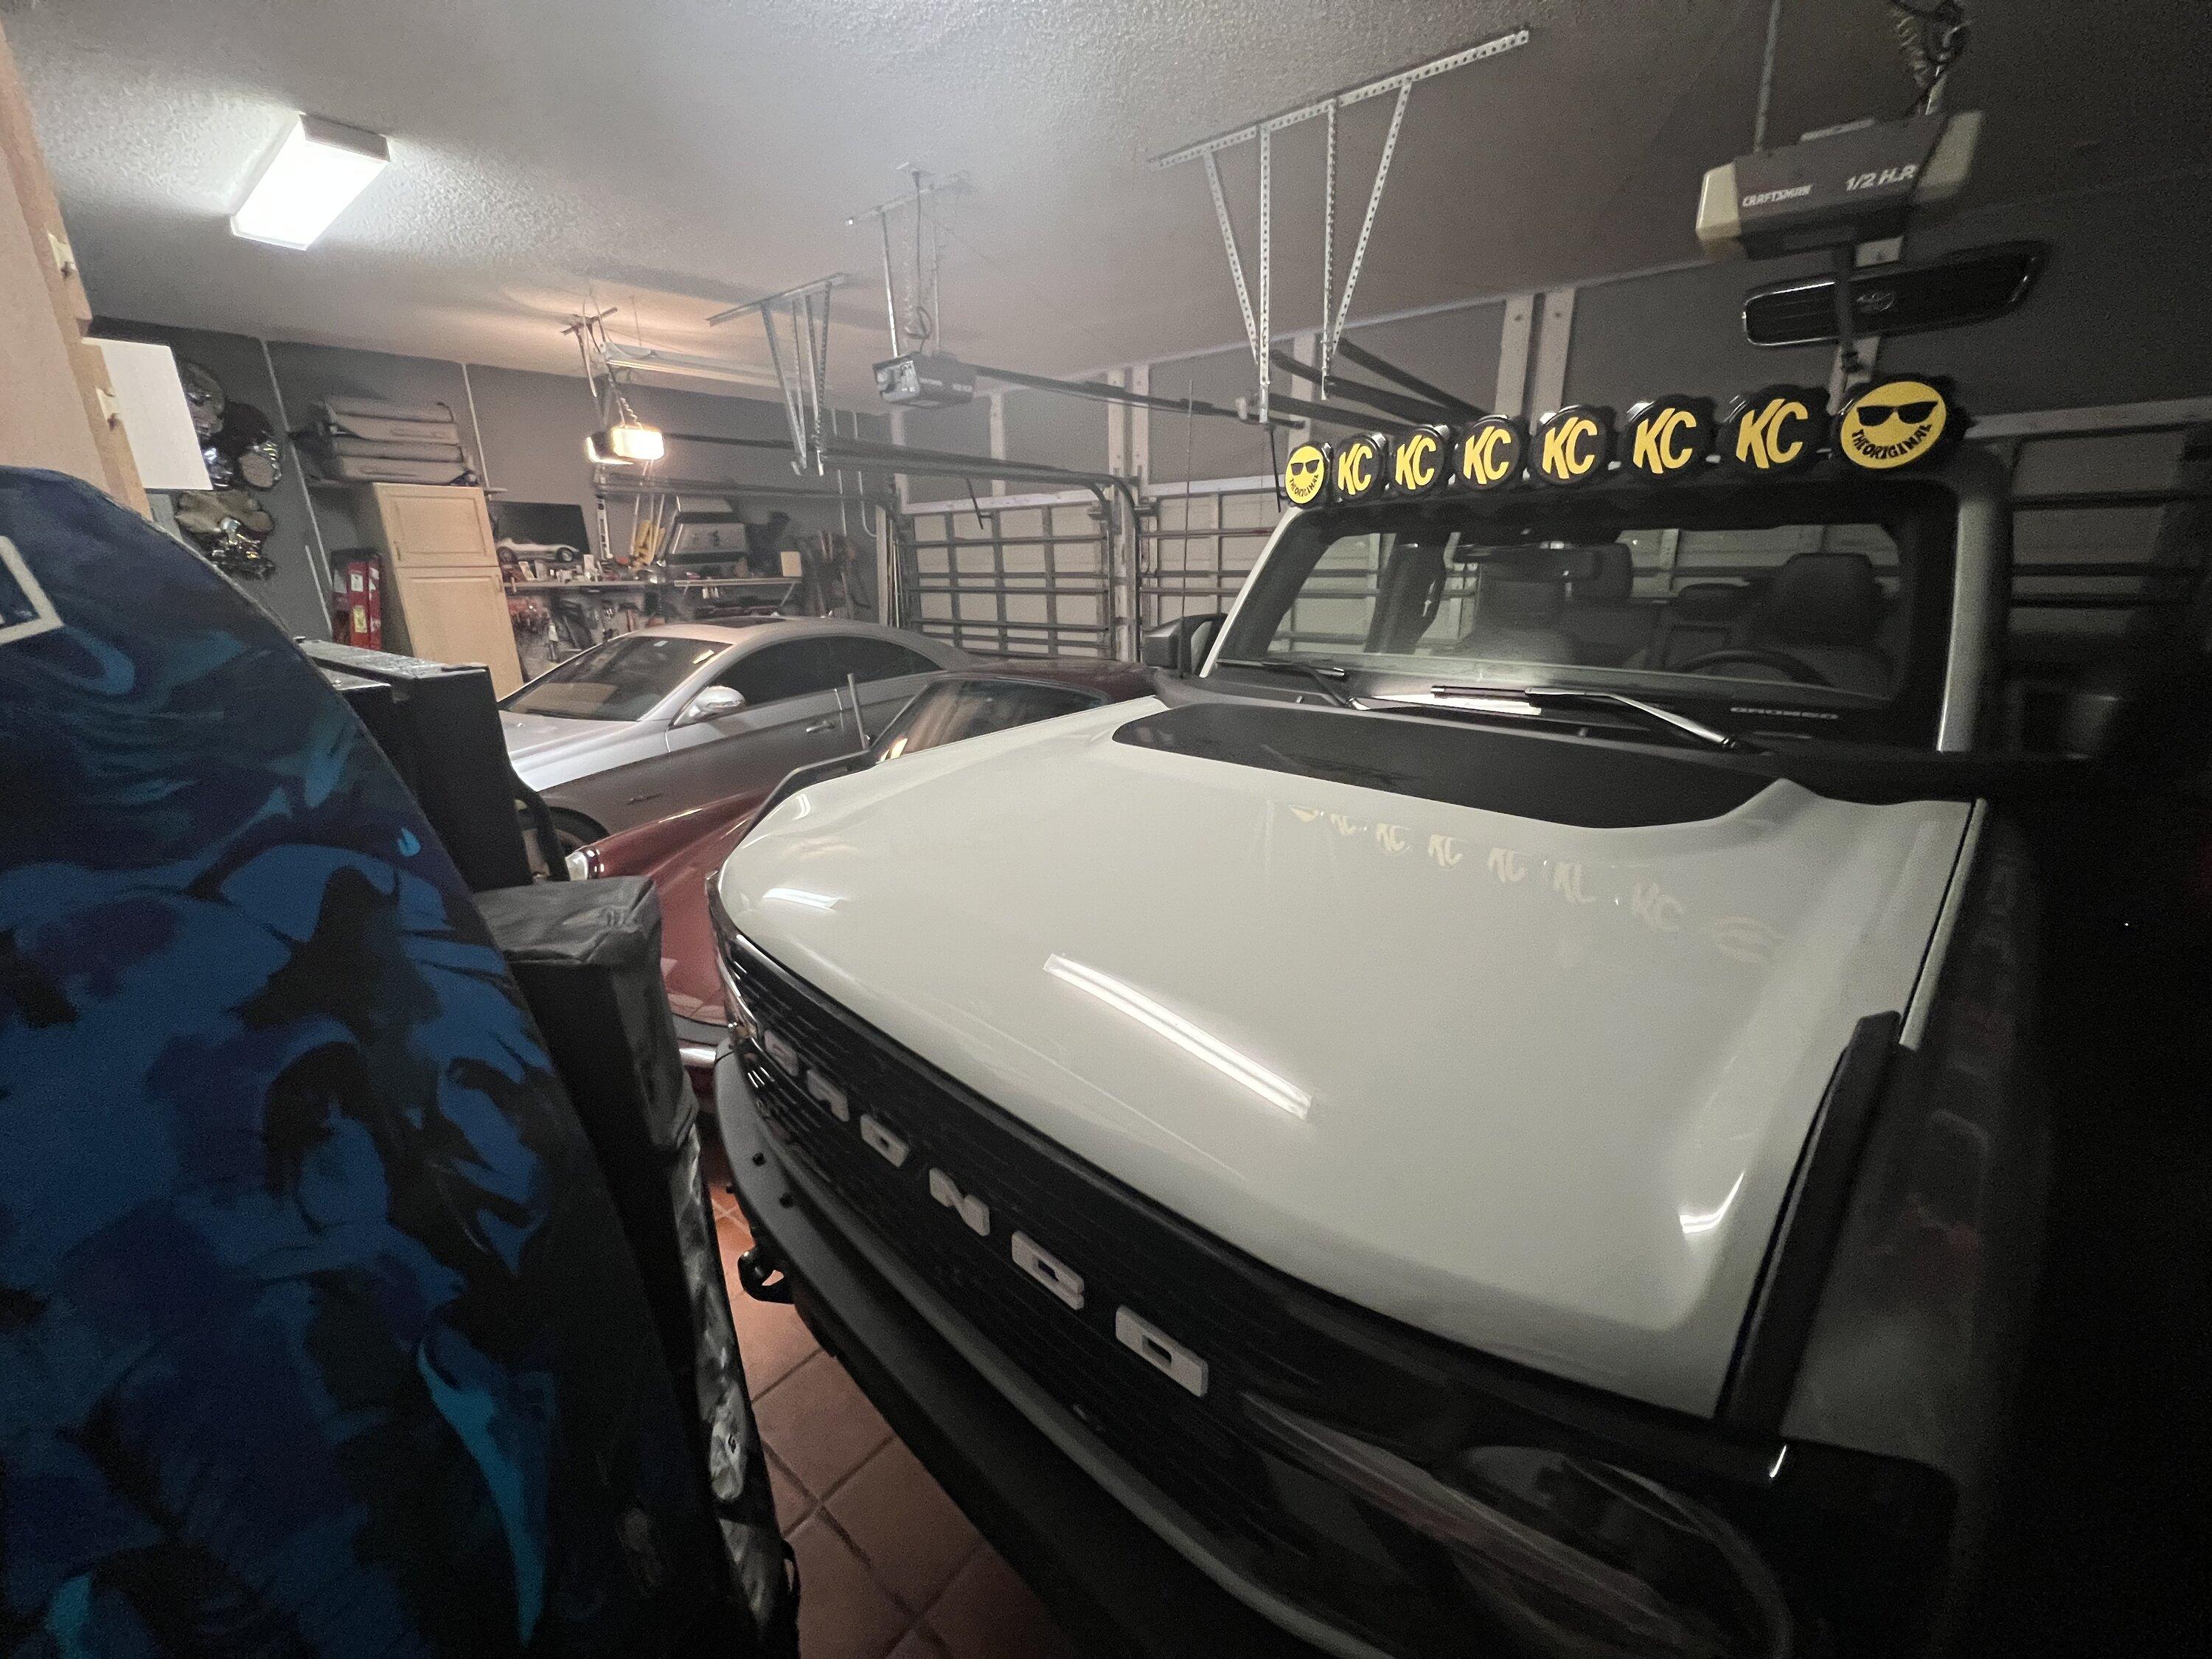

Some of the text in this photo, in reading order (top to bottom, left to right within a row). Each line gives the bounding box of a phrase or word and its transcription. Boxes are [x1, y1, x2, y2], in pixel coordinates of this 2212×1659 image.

[1742, 184, 1812, 207] CRAFTSMAN
[1846, 173, 1877, 192] 1/2
[1395, 435, 1436, 490] KC
[1464, 426, 1511, 484] KC
[1543, 417, 1597, 479] KC
[1633, 408, 1696, 474] KC
[1736, 399, 1808, 468] KC
[1338, 444, 1372, 495] KC
[764, 1029, 1208, 1397] BRONCO
